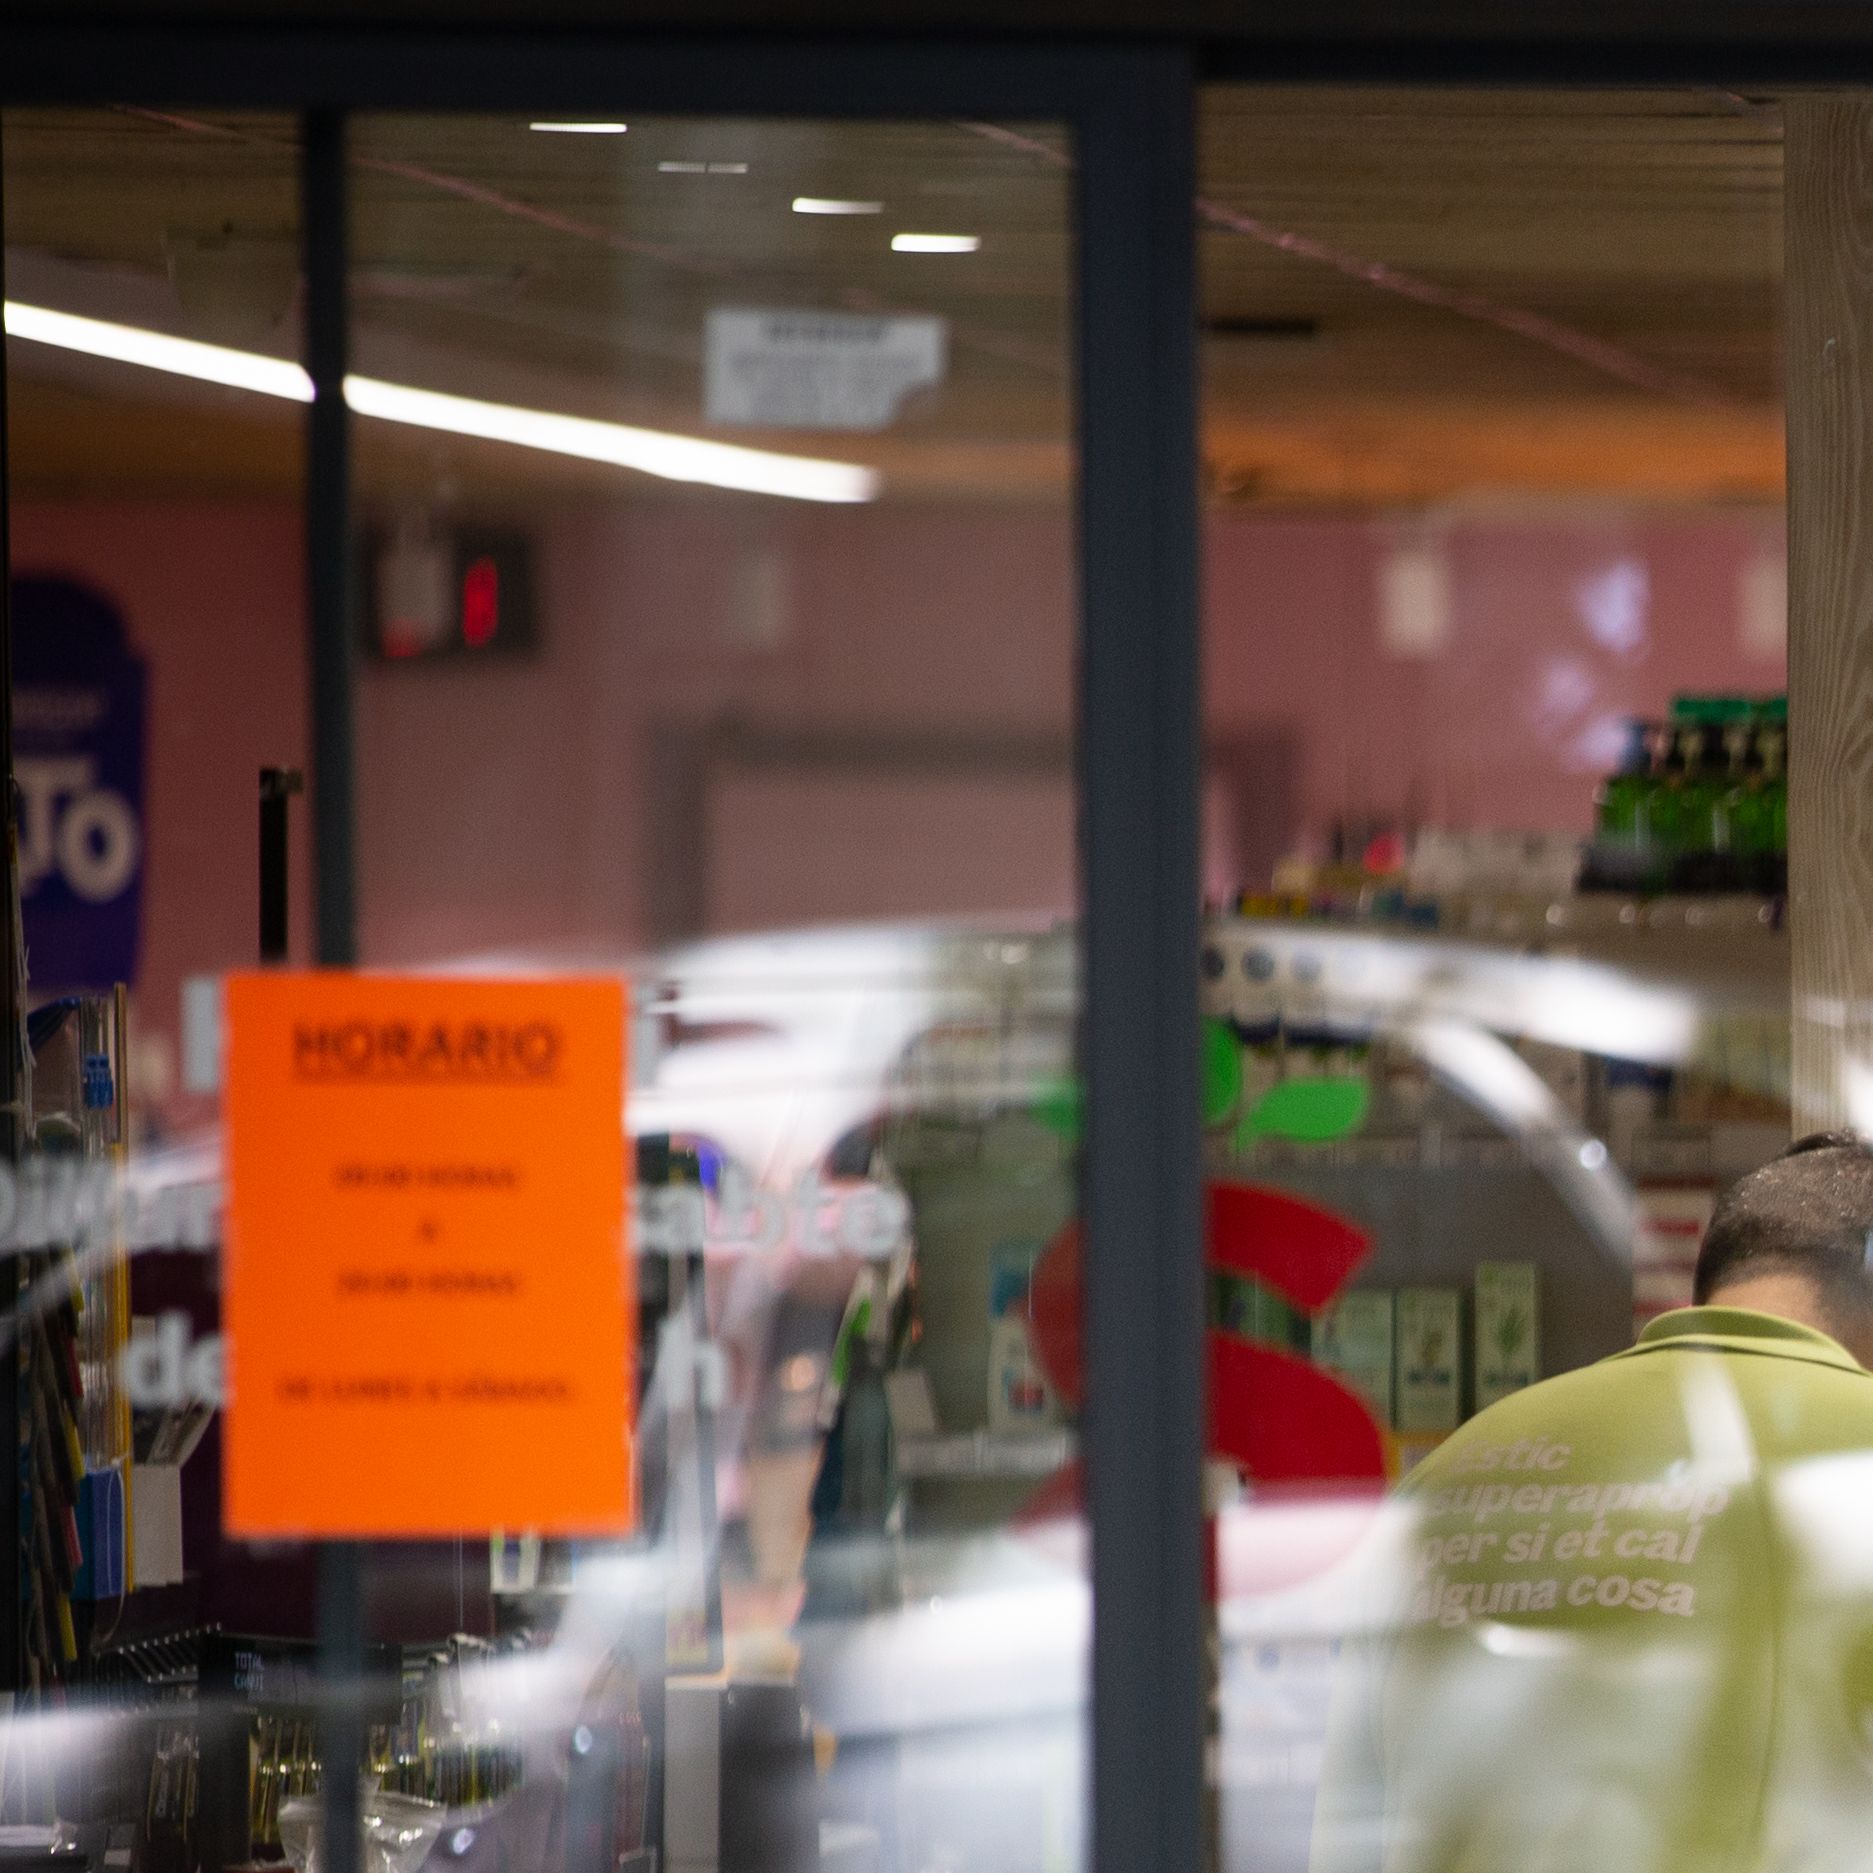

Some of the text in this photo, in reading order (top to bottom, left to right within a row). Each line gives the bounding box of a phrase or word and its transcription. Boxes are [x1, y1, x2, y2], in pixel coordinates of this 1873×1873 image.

[293, 1020, 562, 1076] HORARIO
[1503, 1521, 1552, 1564] si
[1554, 1514, 1610, 1561] et
[1614, 1522, 1704, 1565] cal
[1566, 1575, 1696, 1618] cosa
